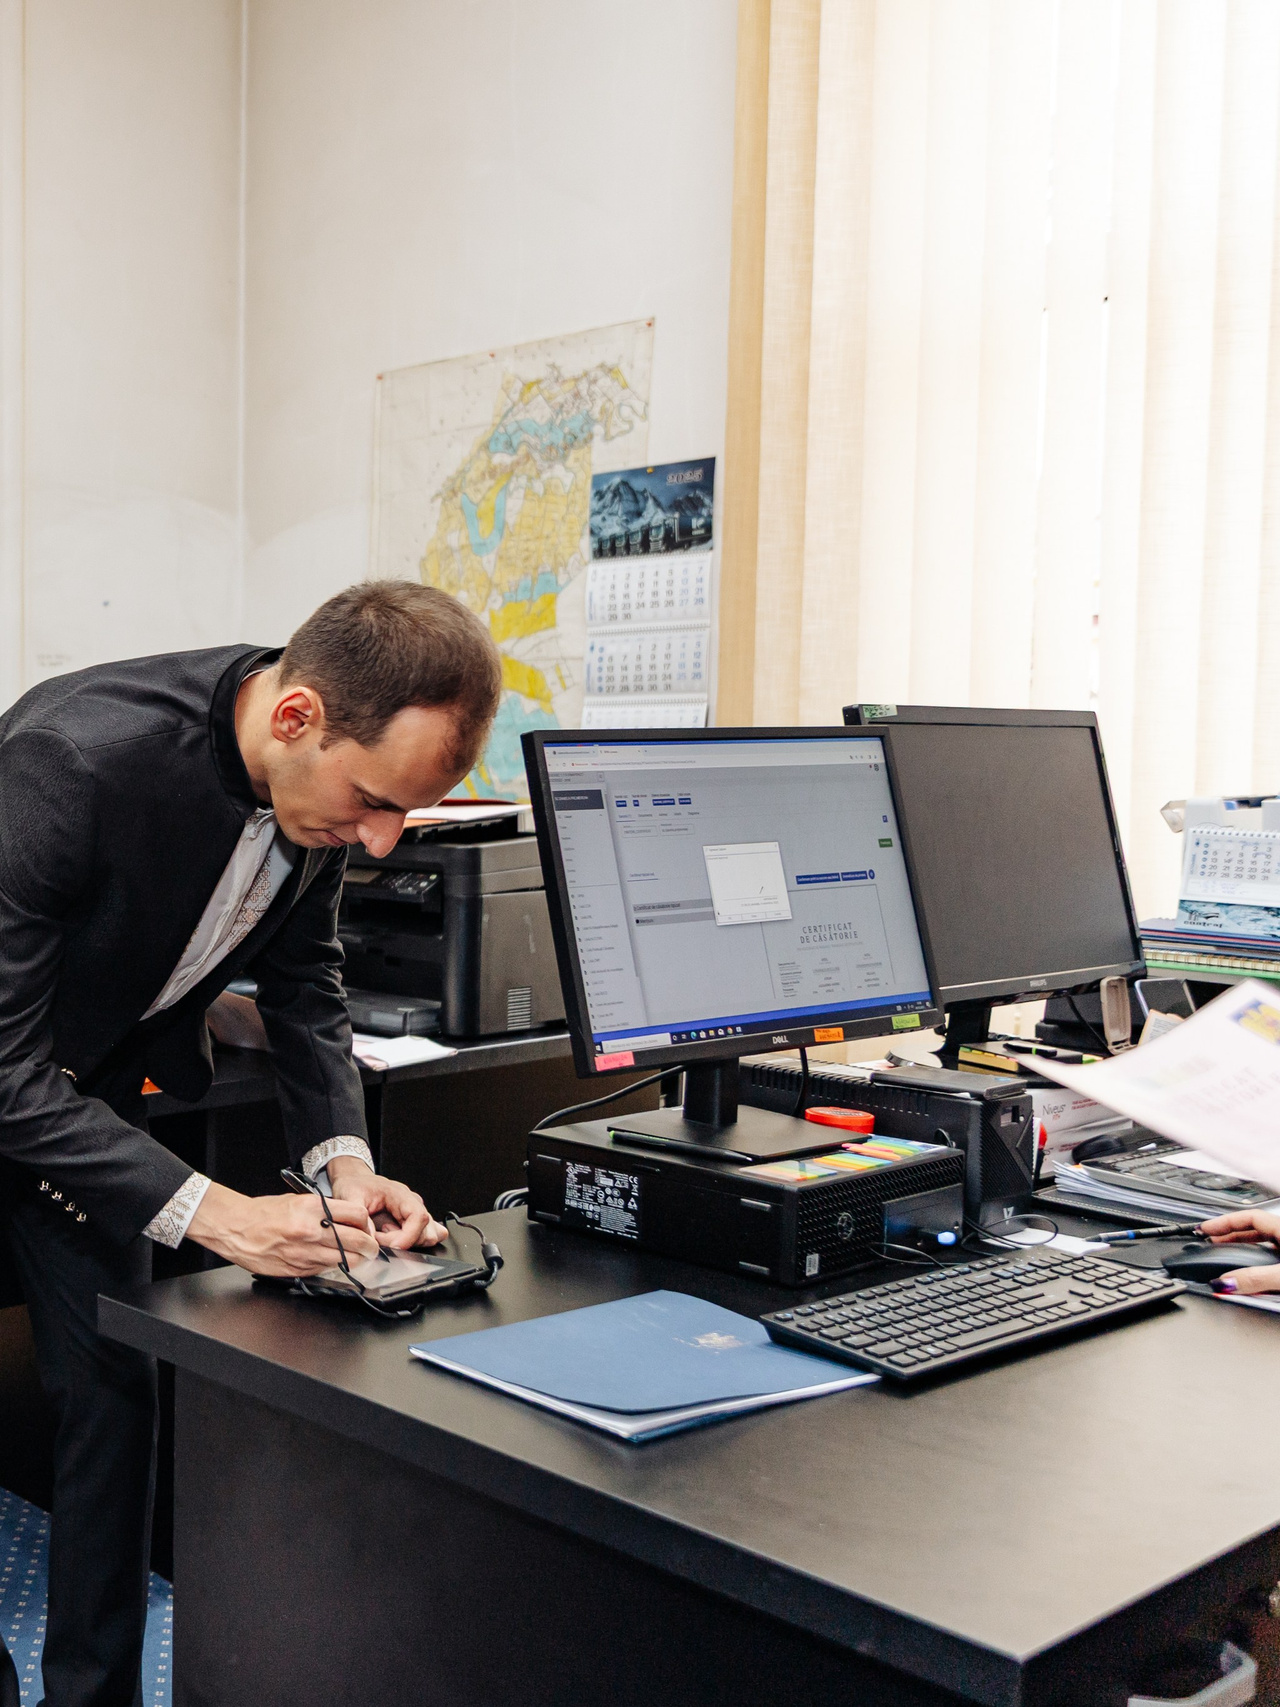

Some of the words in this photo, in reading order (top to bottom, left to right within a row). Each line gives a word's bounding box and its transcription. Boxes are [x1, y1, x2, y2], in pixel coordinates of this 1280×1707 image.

[666, 468, 703, 485] 2025
[802, 922, 853, 934] CERTIFICAT
[800, 936, 810, 944] DE
[772, 1035, 789, 1045] DELL
[1042, 1104, 1066, 1116] Niveus
